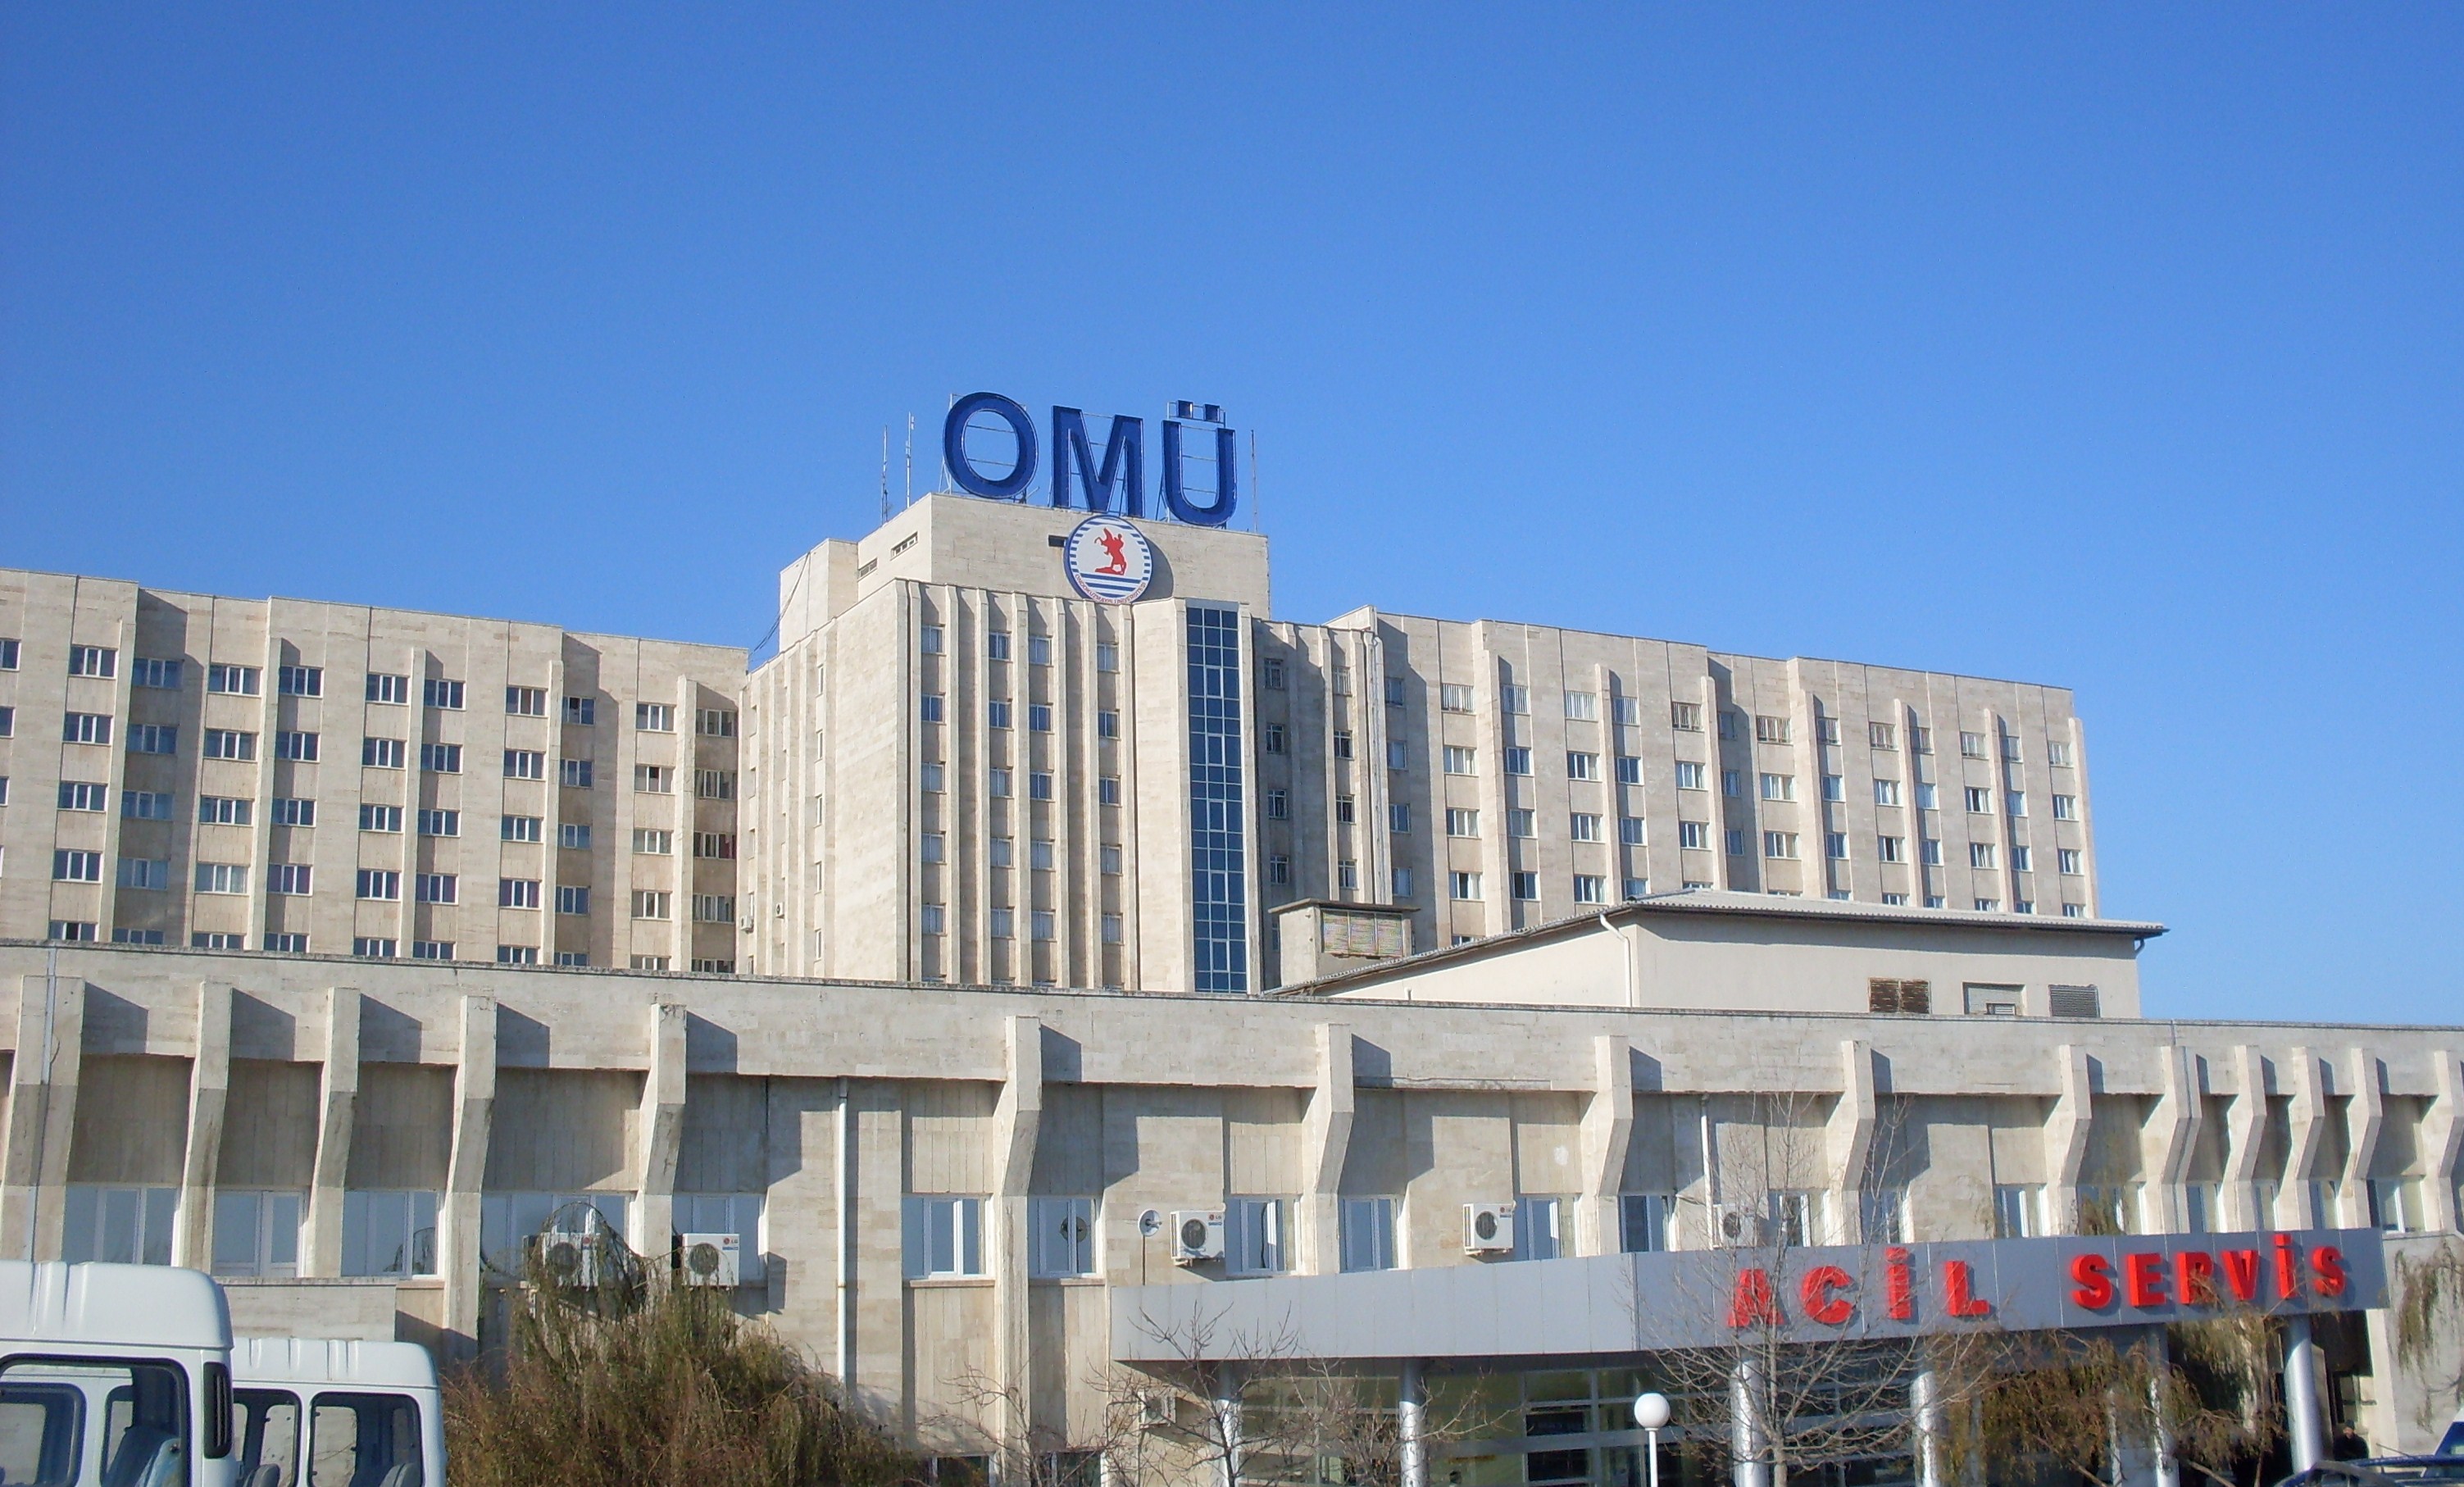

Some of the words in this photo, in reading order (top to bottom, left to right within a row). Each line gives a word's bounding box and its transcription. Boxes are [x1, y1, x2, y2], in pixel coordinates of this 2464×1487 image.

[943, 392, 1237, 526] OMÜ
[1727, 1247, 1990, 1327] ACİL
[2071, 1234, 2346, 1309] SERVİS
